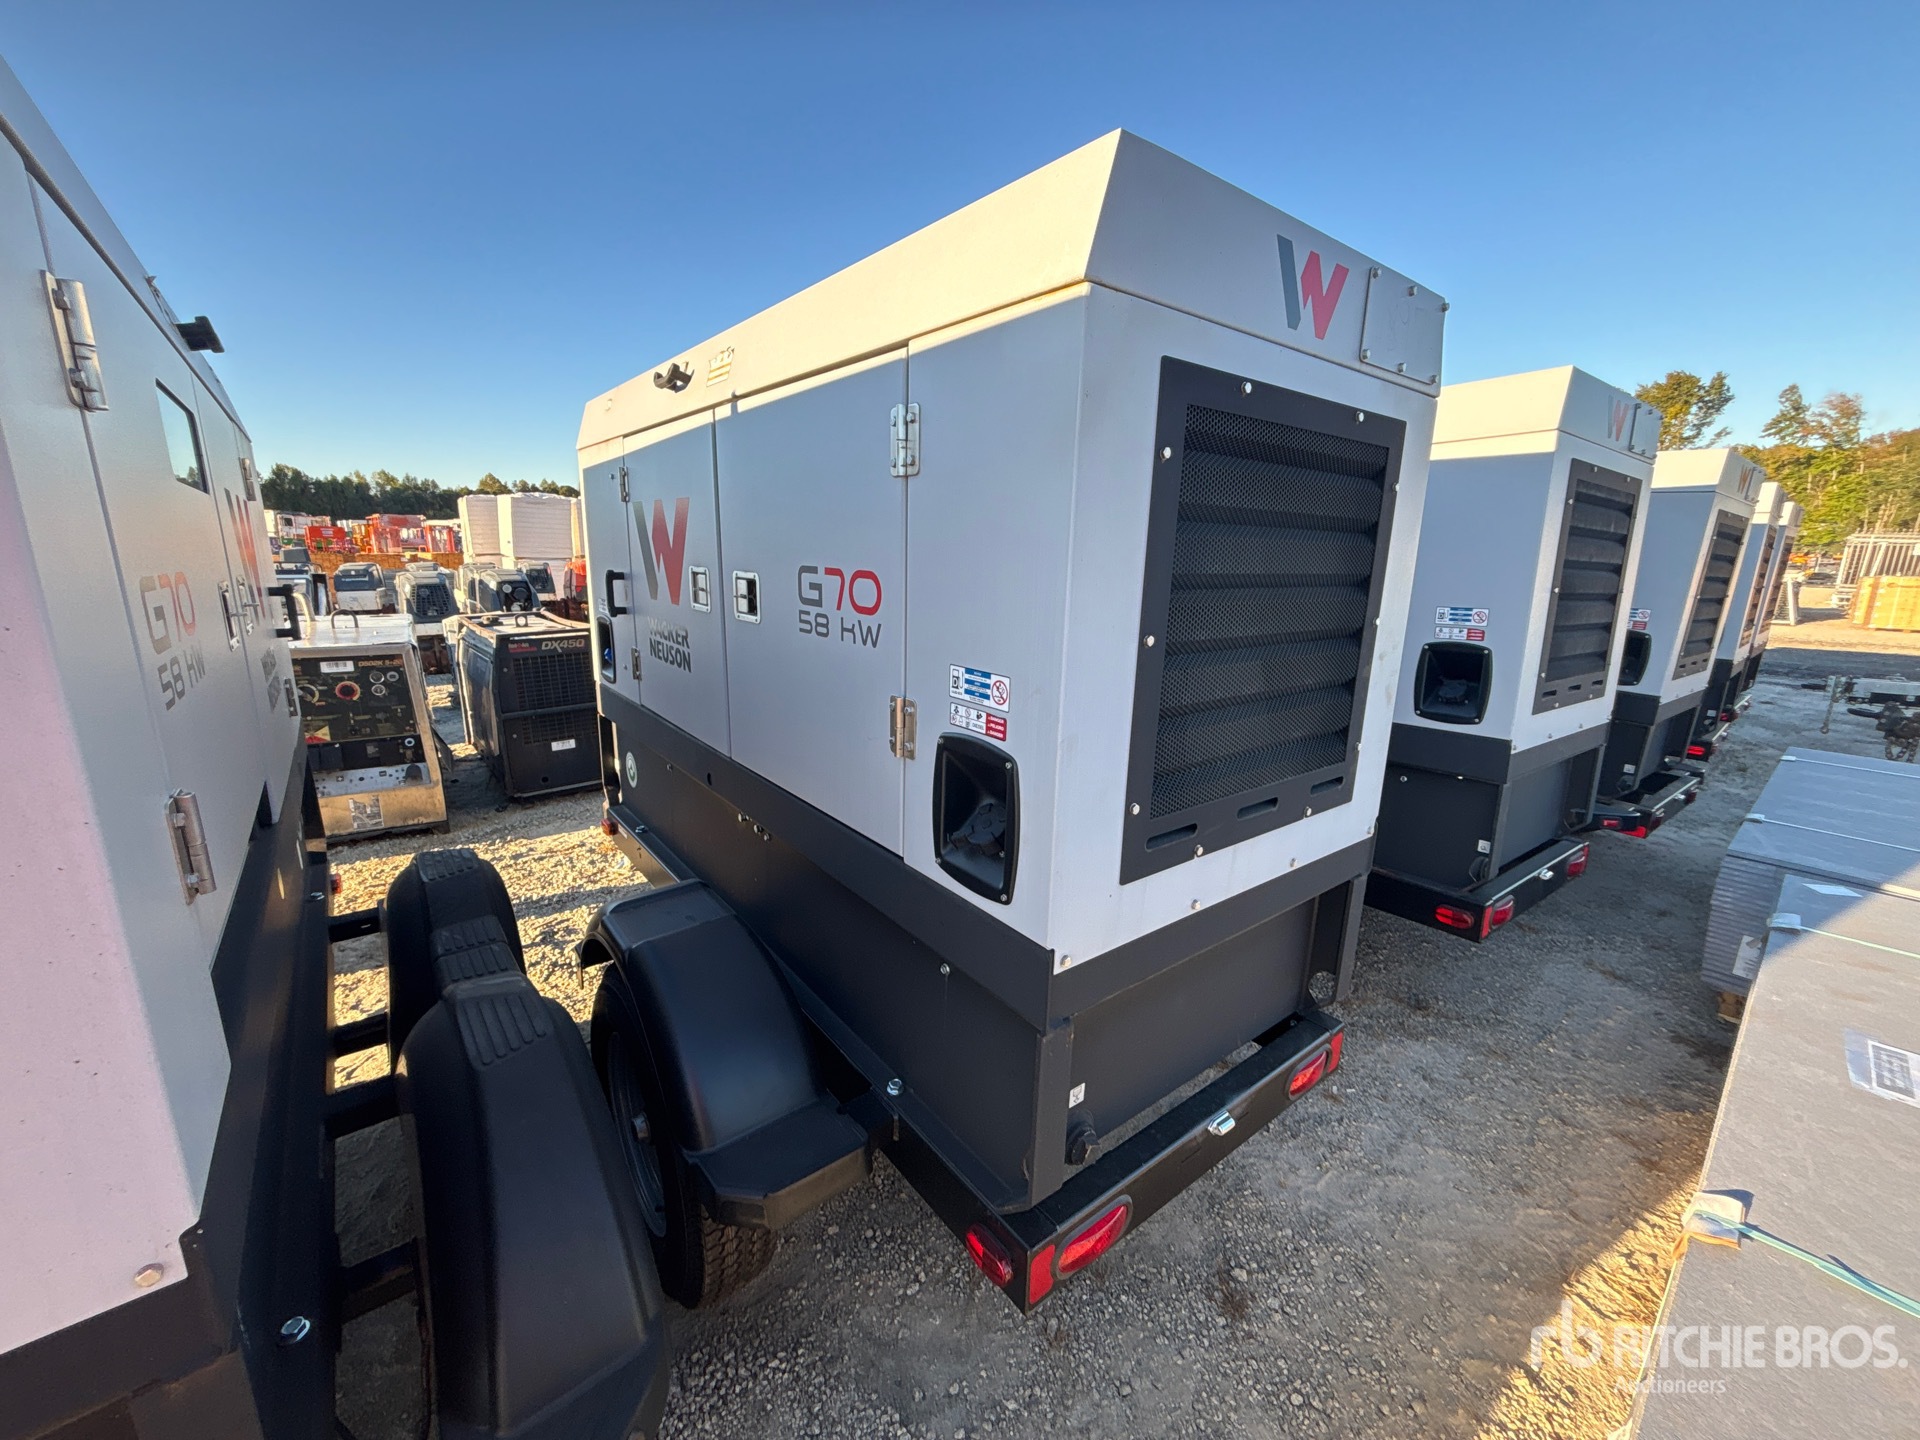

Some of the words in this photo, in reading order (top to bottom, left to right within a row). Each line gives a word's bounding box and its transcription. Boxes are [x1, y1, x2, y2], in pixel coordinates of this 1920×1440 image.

[798, 565, 882, 616] G70
[139, 571, 195, 655] G70
[799, 609, 829, 638] 58
[541, 639, 585, 653] DX450
[648, 616, 690, 649] WACKER
[650, 637, 692, 673] NEUSON
[157, 655, 186, 711] 58
